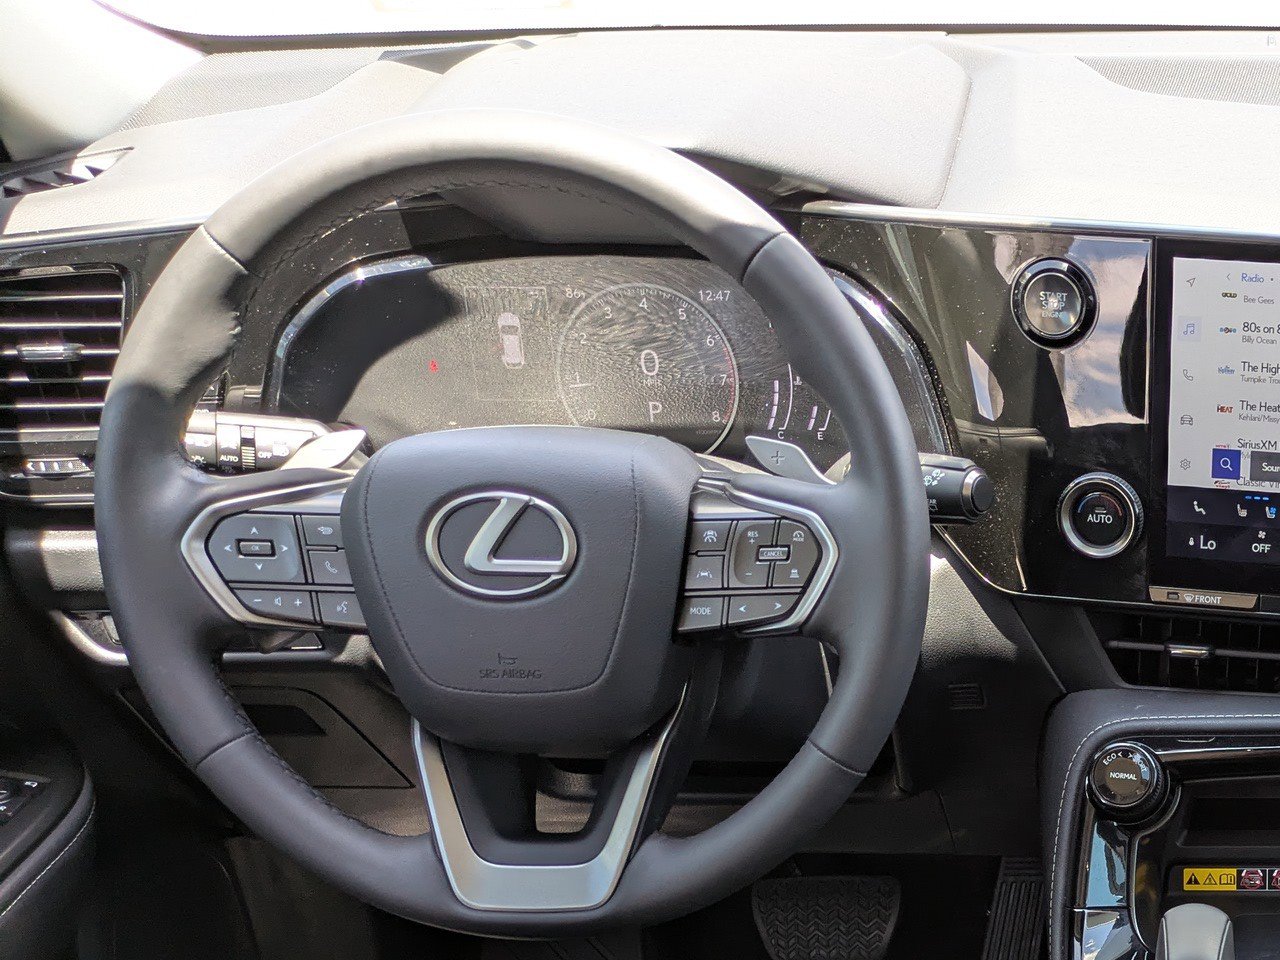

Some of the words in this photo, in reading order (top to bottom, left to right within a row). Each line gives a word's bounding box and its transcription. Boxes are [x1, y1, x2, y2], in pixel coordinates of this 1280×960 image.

[1241, 273, 1264, 283] Radio
[698, 290, 731, 301] 12:47
[1040, 291, 1068, 301] START
[1243, 295, 1256, 304] Bee
[1258, 296, 1275, 305] Gees
[639, 297, 648, 310] 4
[604, 307, 613, 319] 3
[678, 308, 687, 320] 5
[1242, 321, 1261, 333] 80s
[1263, 326, 1275, 335] on
[579, 333, 587, 344] 2
[706, 335, 715, 346] 6
[1241, 335, 1255, 345] Billy
[1256, 336, 1277, 345] Ocean
[640, 349, 659, 376] 0
[1241, 361, 1258, 373] The
[719, 374, 727, 385] 7
[649, 401, 662, 422] P
[1216, 405, 1233, 414] HEAT
[1240, 400, 1257, 411] The
[1259, 401, 1280, 413] Heat
[712, 410, 720, 422] 8
[777, 431, 784, 440] C
[817, 432, 824, 440] E
[1237, 438, 1277, 451] SiriusXM
[1087, 513, 1113, 524] AUTO
[1200, 535, 1217, 550] Lo
[1251, 543, 1272, 553] OFF
[1194, 595, 1222, 604] FRONT
[690, 607, 712, 615] MODE
[479, 669, 499, 679] SRS
[502, 669, 542, 679] AIRBAG
[1102, 753, 1117, 766] ECO
[1110, 771, 1137, 780] NORMAL
